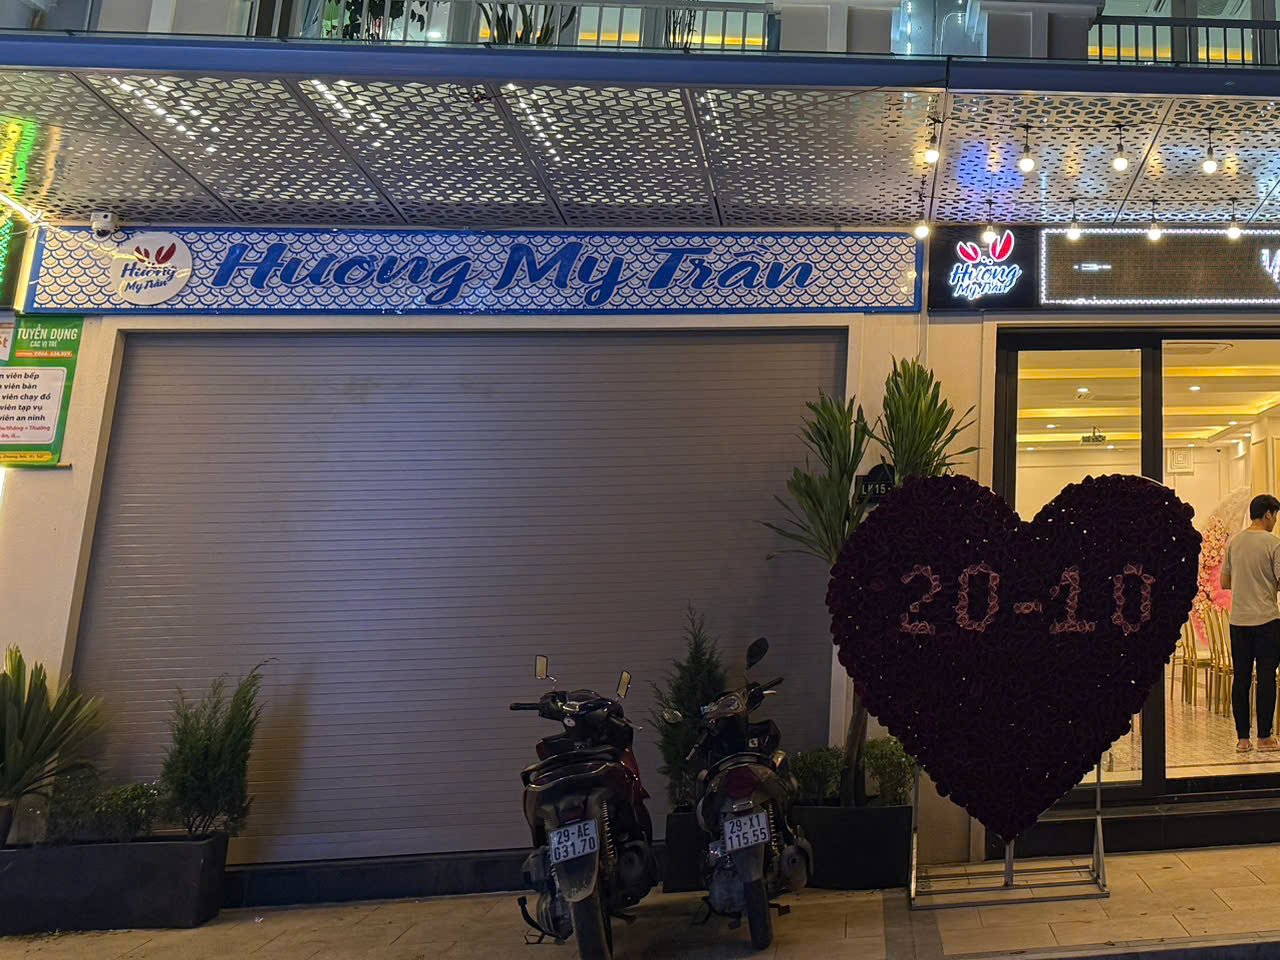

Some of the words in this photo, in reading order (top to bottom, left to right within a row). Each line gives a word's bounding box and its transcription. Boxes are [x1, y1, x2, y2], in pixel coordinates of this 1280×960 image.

[211, 242, 481, 307] Hương
[493, 241, 639, 307] My
[647, 243, 821, 291] Trần
[124, 281, 142, 294] My
[17, 324, 48, 340] TUYỂN
[50, 328, 78, 342] DỤNG
[900, 563, 1157, 635] 20-10
[556, 823, 591, 845] 29-AE
[729, 814, 761, 834] 29-X1
[553, 836, 596, 861] 031.70
[727, 827, 767, 849] 115.55
